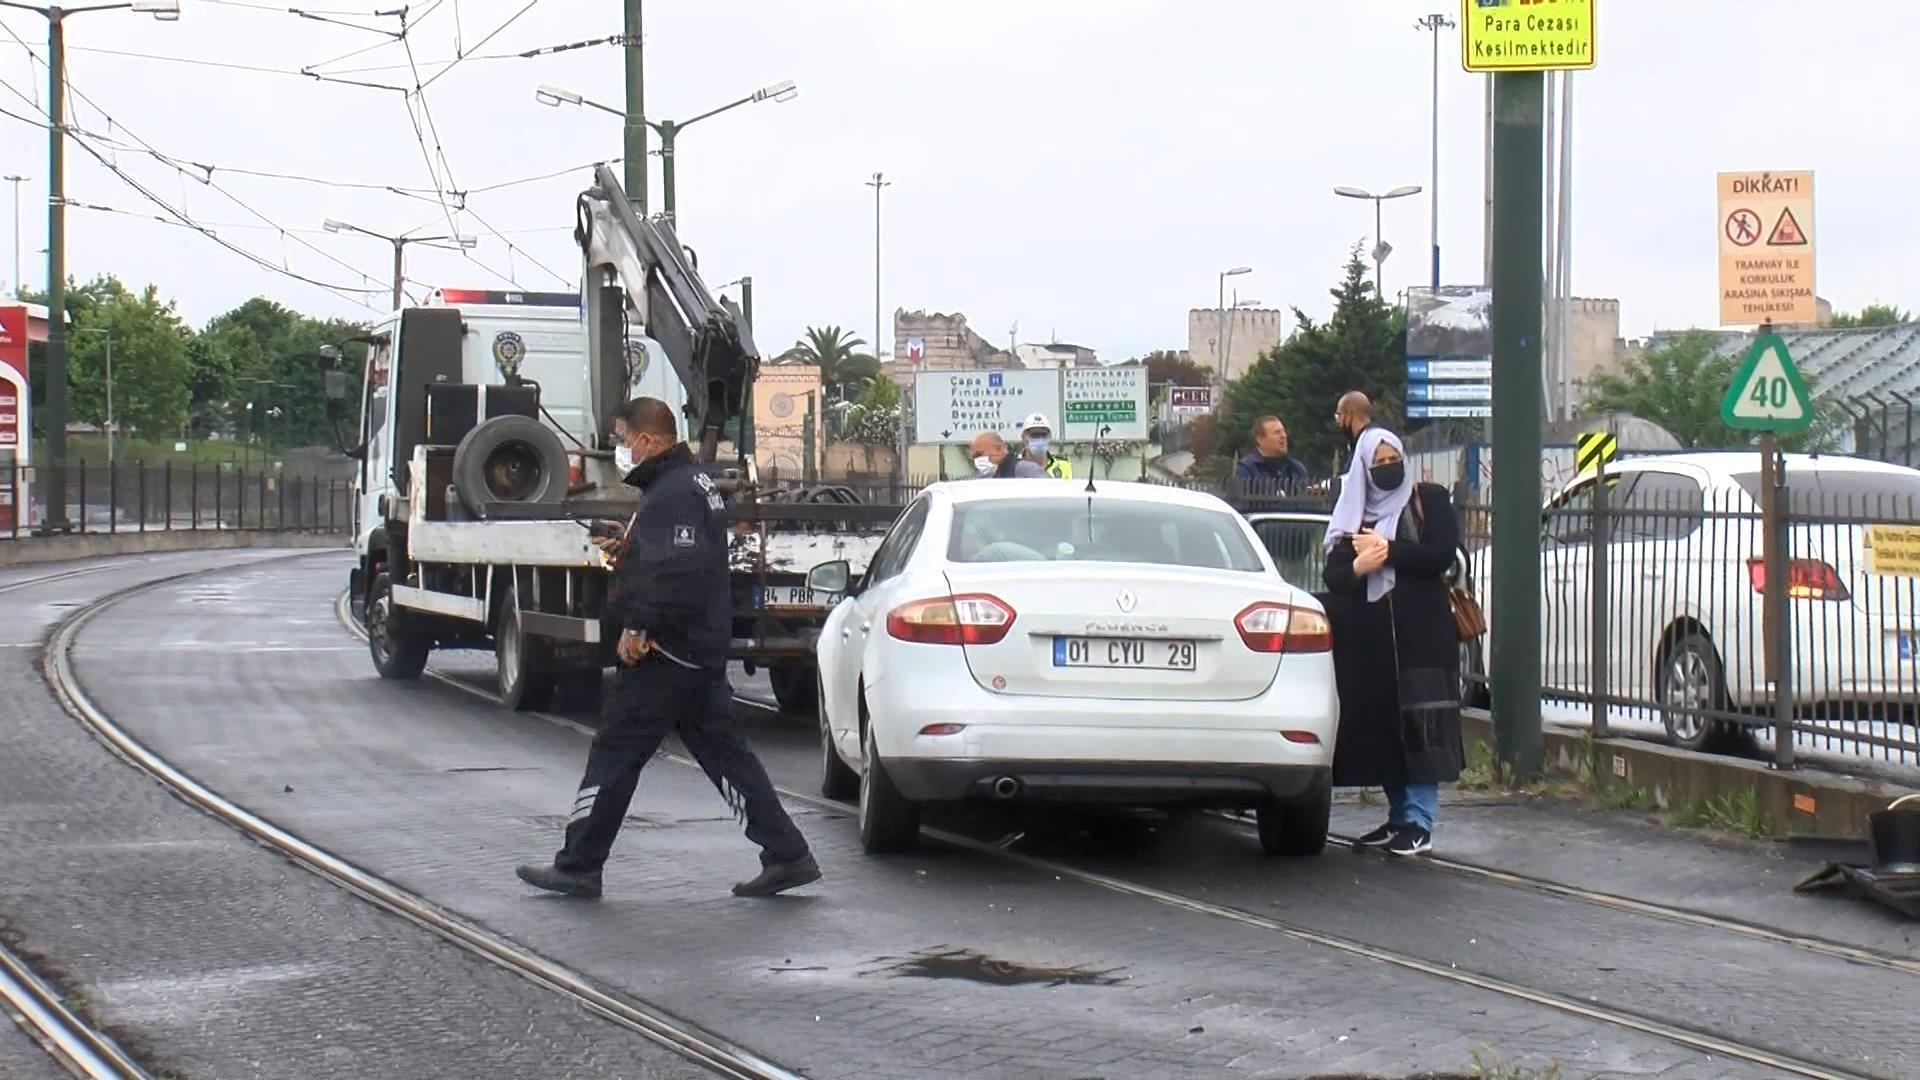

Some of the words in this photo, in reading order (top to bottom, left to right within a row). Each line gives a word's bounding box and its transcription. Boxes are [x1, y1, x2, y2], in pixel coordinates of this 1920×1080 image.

[1485, 15, 1520, 32] Para
[1527, 14, 1578, 31] Cezası
[1475, 38, 1588, 57] Kesilmektedir
[1733, 176, 1798, 193] DİKKAT!
[1735, 260, 1783, 270] TRAMVAY
[1786, 258, 1800, 269] İLE
[1740, 274, 1796, 284] KORKULUK
[1724, 289, 1768, 300] ARASINA
[1771, 288, 1813, 300] SIKIŞMA
[1751, 376, 1787, 408] 40
[951, 399, 1002, 409] Aksaray
[790, 587, 814, 604] PBR
[1069, 640, 1088, 663] 01
[1108, 641, 1144, 665] CYU
[1168, 643, 1191, 666] 29
